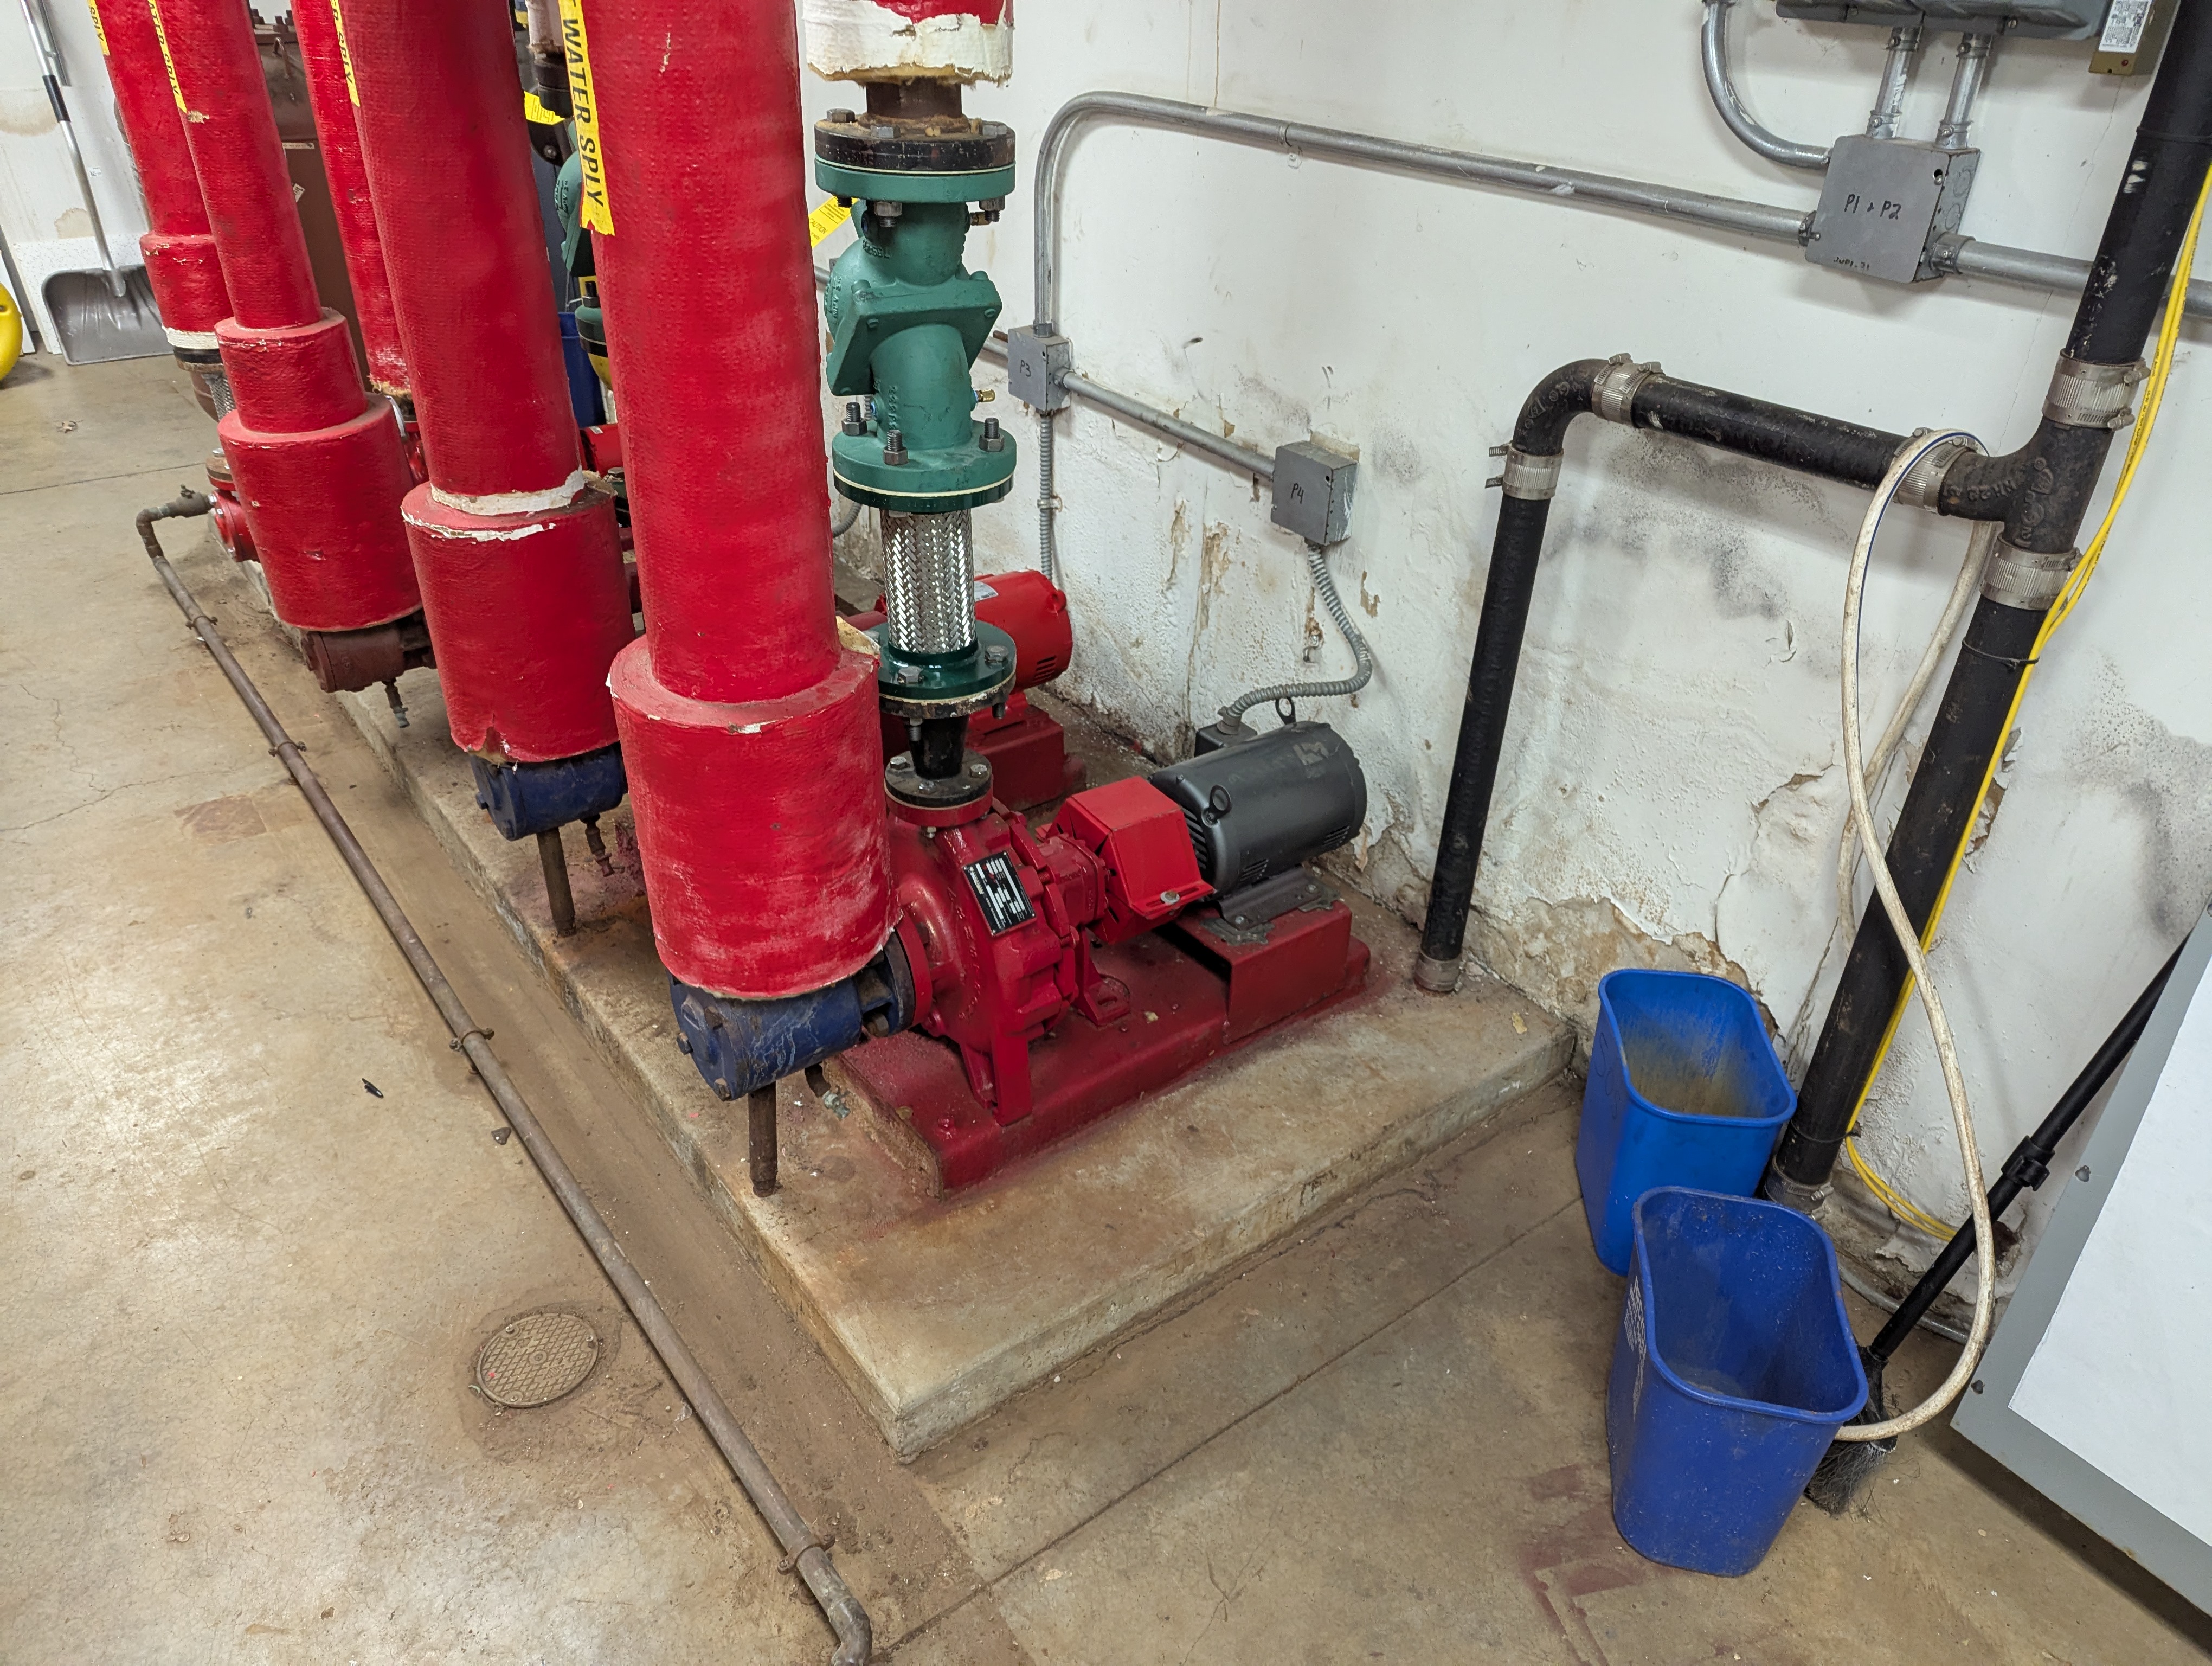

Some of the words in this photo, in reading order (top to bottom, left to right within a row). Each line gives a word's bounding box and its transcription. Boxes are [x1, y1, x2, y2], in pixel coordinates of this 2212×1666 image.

[563, 18, 591, 124] WATER
[580, 134, 604, 207] SPLY
[1844, 194, 1860, 213] P1
[1880, 200, 1901, 220] P2
[810, 217, 828, 234] CAUTION
[1020, 360, 1031, 377] P3
[1290, 483, 1304, 504] P4
